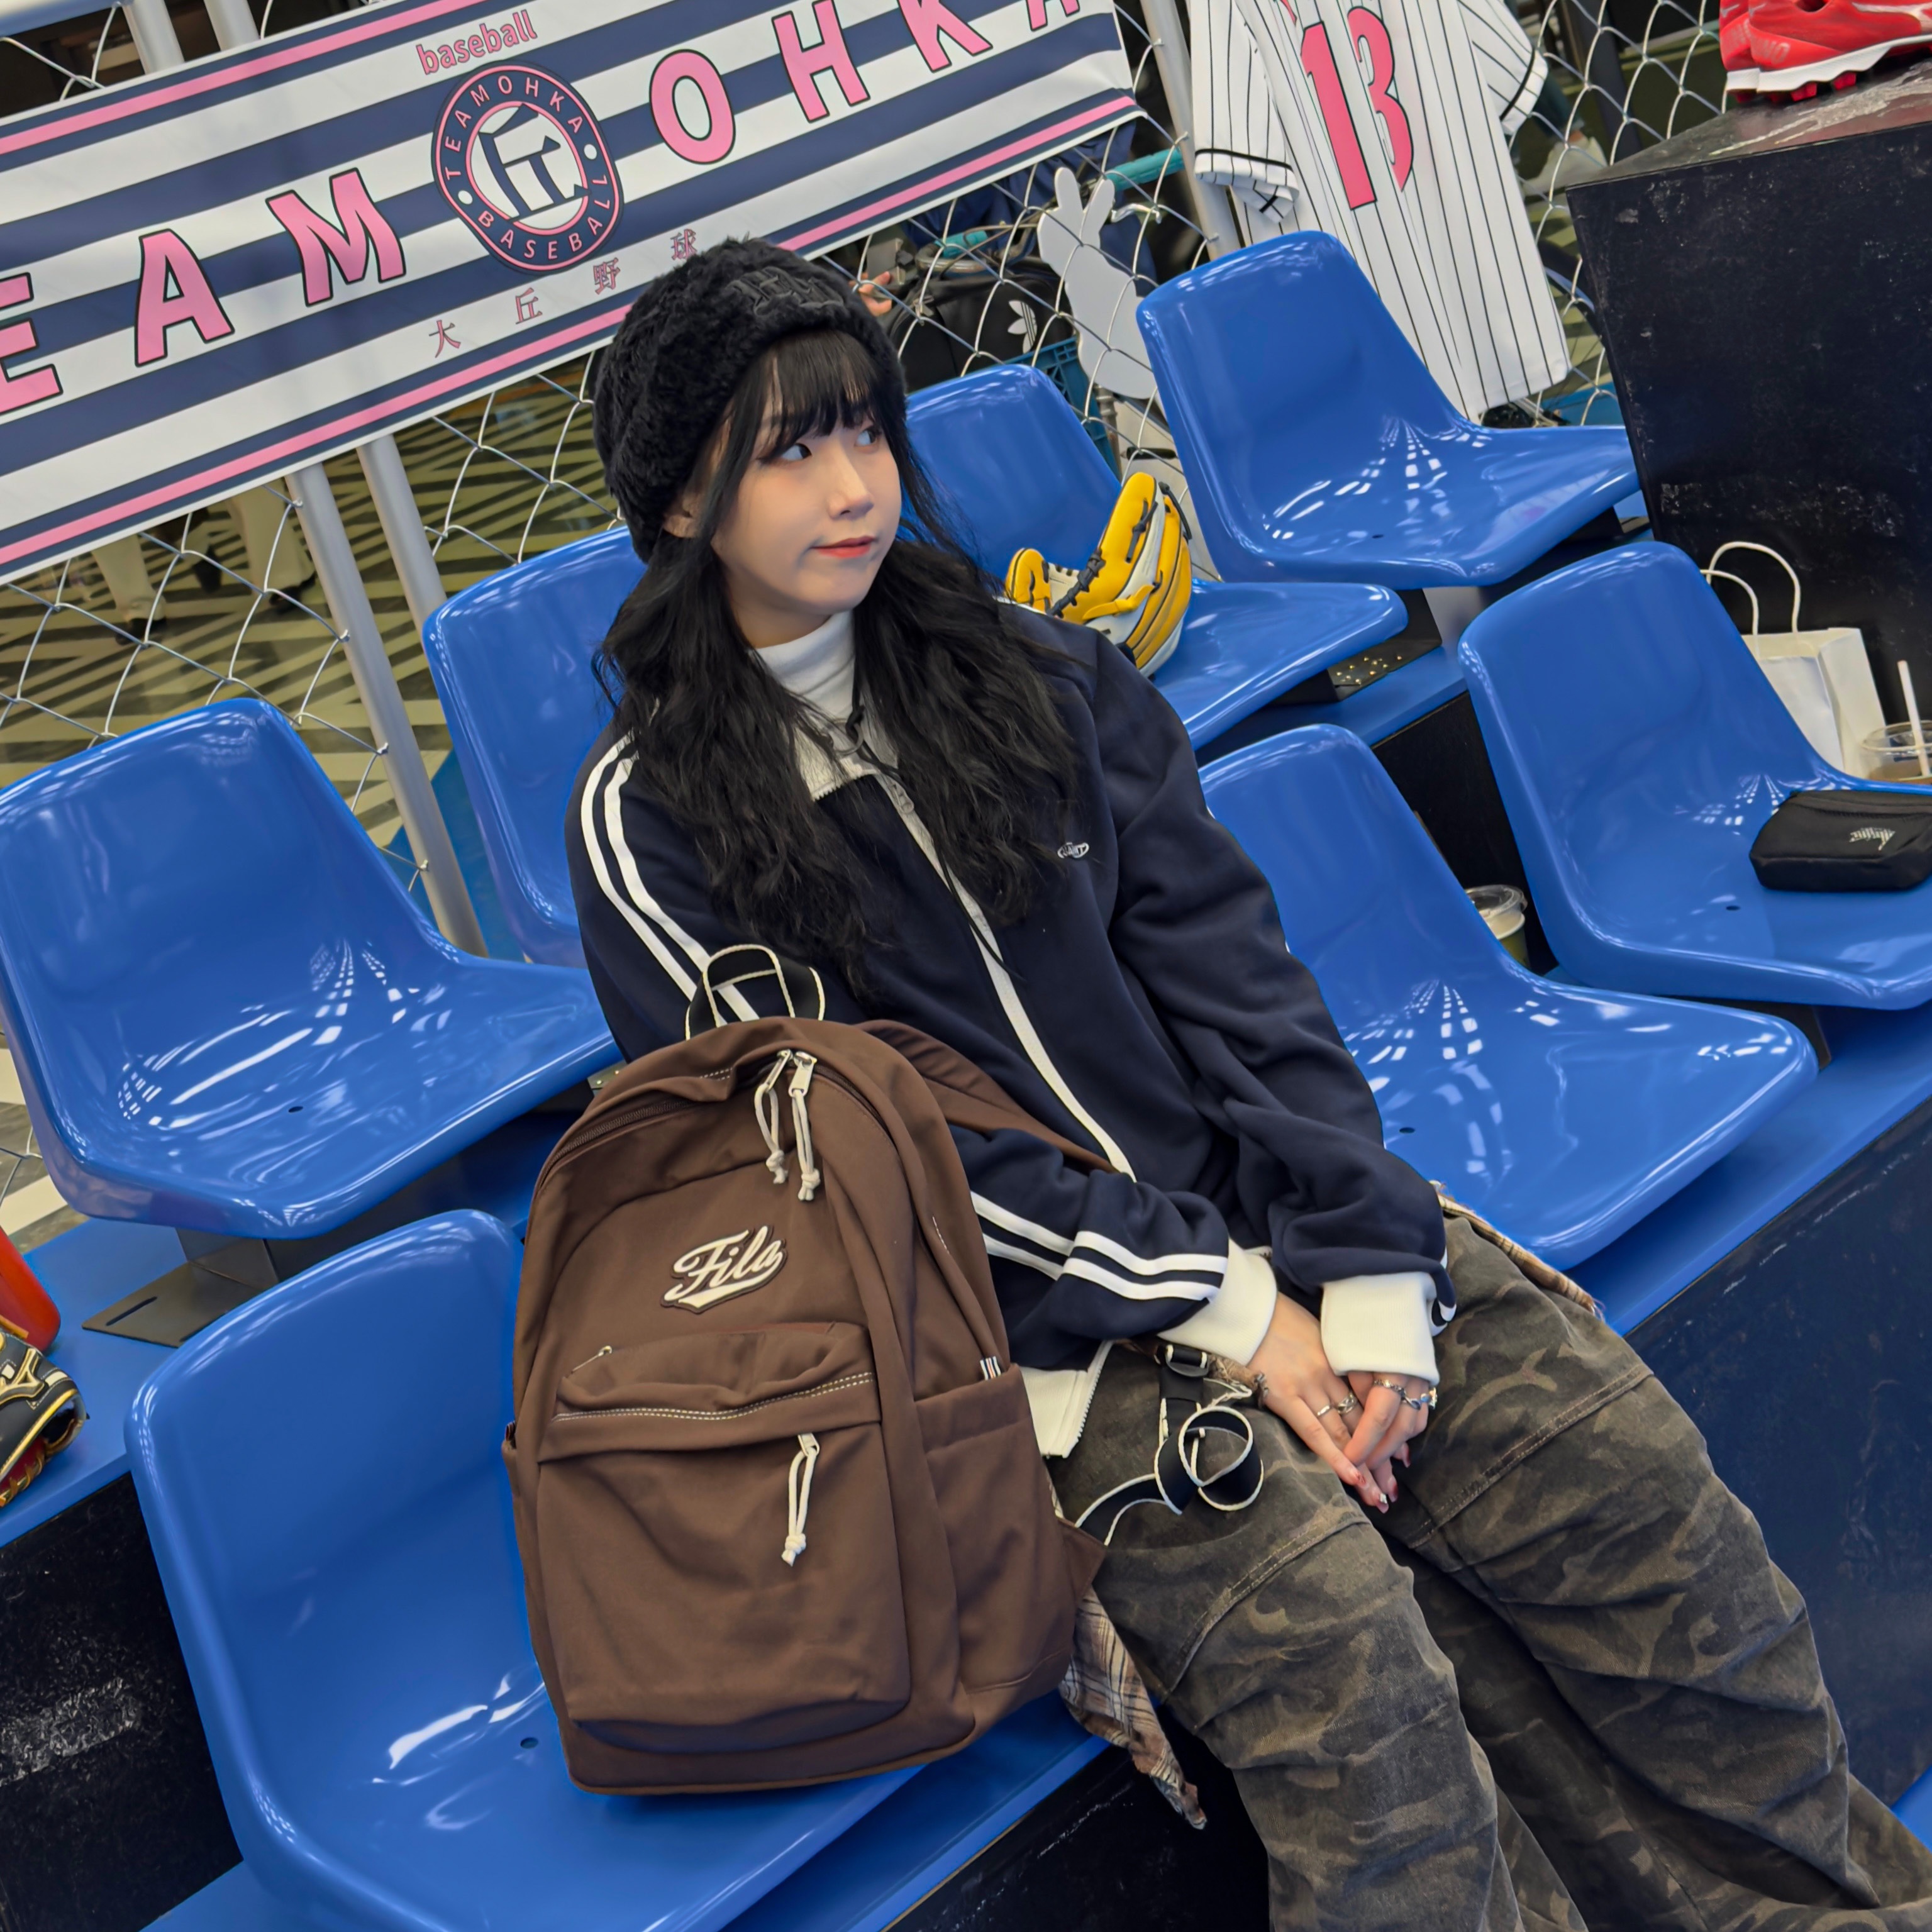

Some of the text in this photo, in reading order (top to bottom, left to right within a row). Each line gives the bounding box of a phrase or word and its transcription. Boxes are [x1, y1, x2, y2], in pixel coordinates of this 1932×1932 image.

[416, 9, 537, 75] baseball
[648, 0, 1081, 165] OHK
[1300, 6, 1414, 211] 13
[478, 175, 610, 260] BASEBALL
[663, 1226, 783, 1308] Fila
